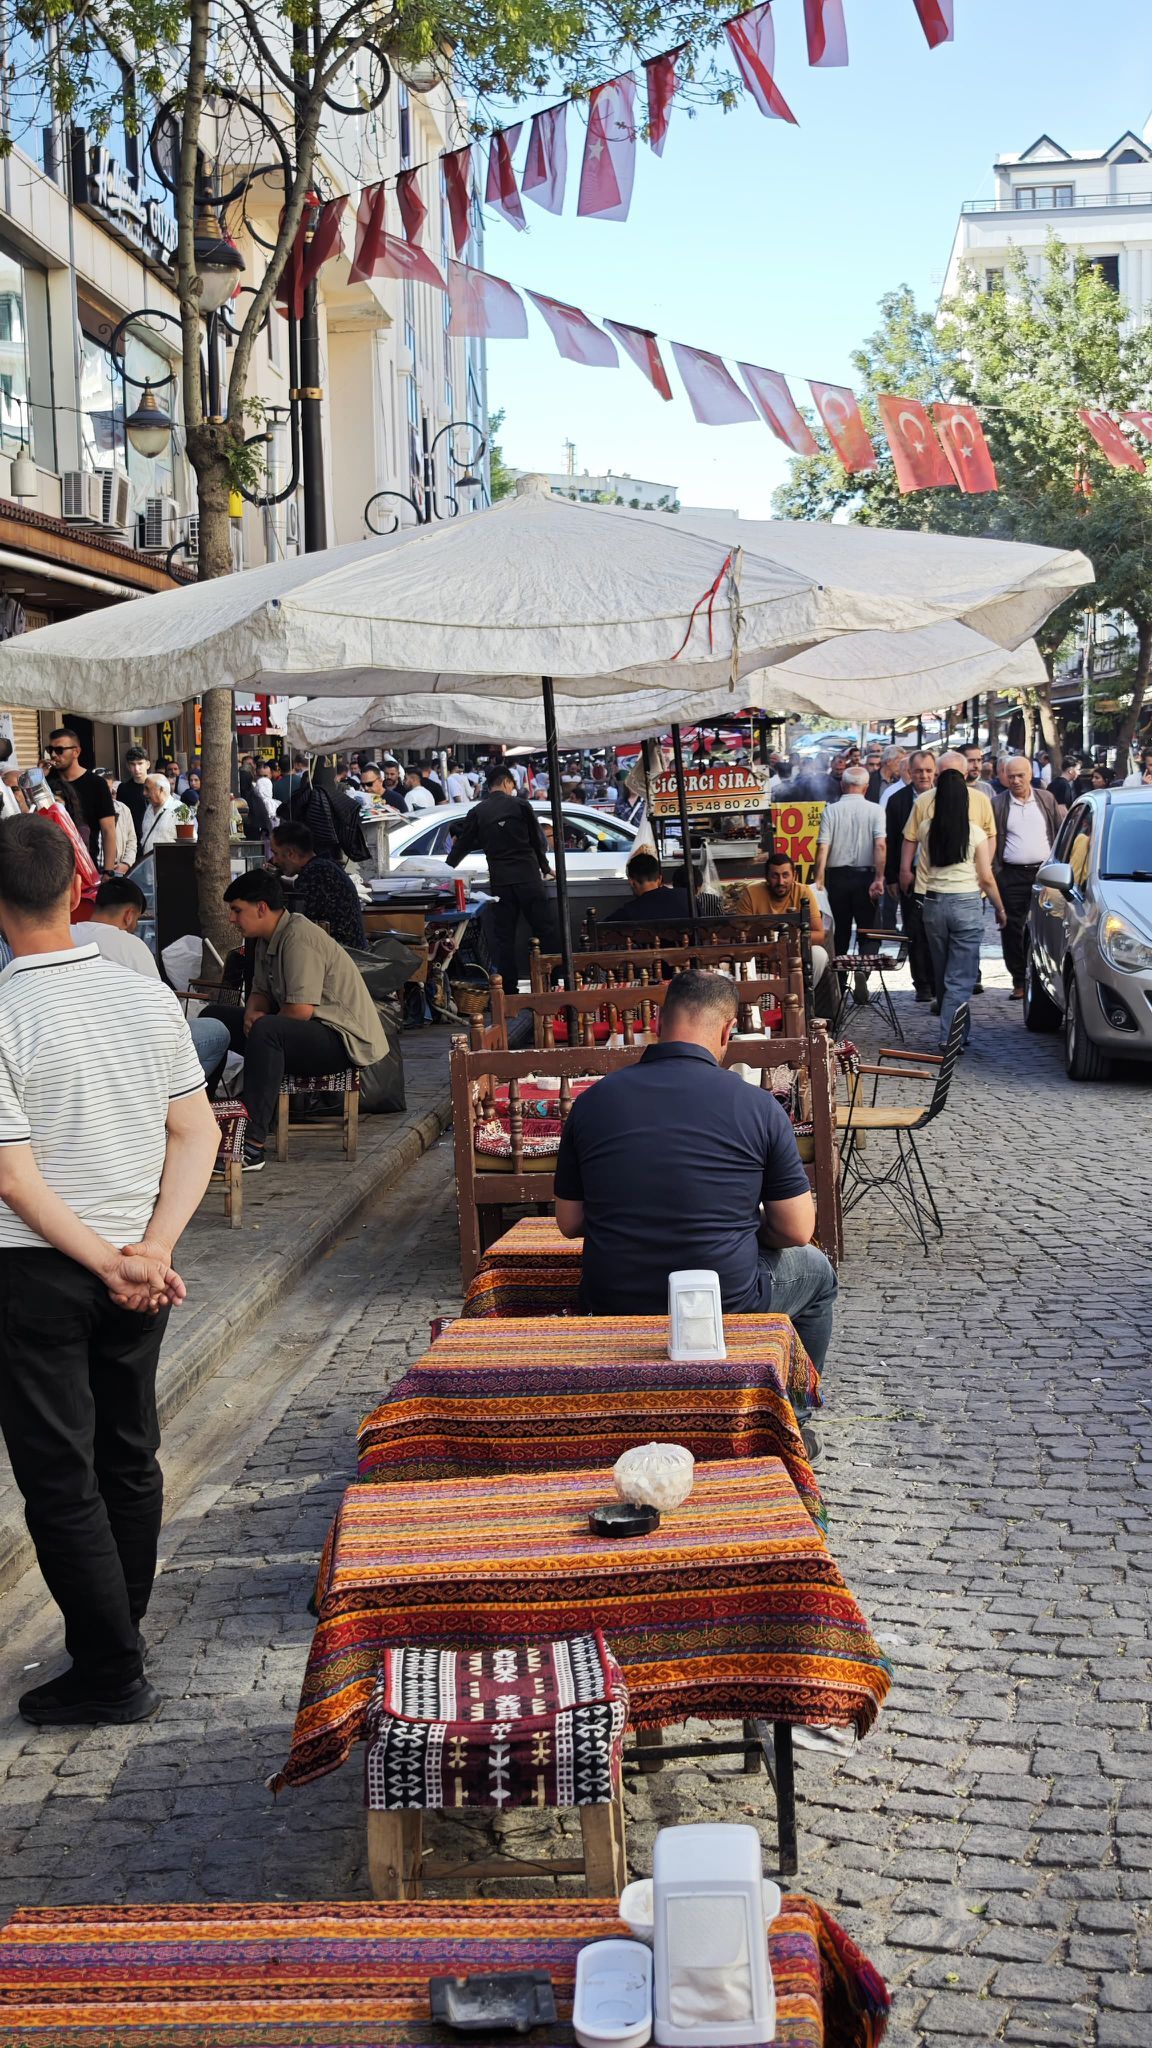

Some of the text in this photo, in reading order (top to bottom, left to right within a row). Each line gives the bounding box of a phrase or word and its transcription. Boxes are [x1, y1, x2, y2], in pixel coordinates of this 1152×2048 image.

[235, 701, 262, 712] RVE
[660, 798, 760, 814] 055 548 80 20
